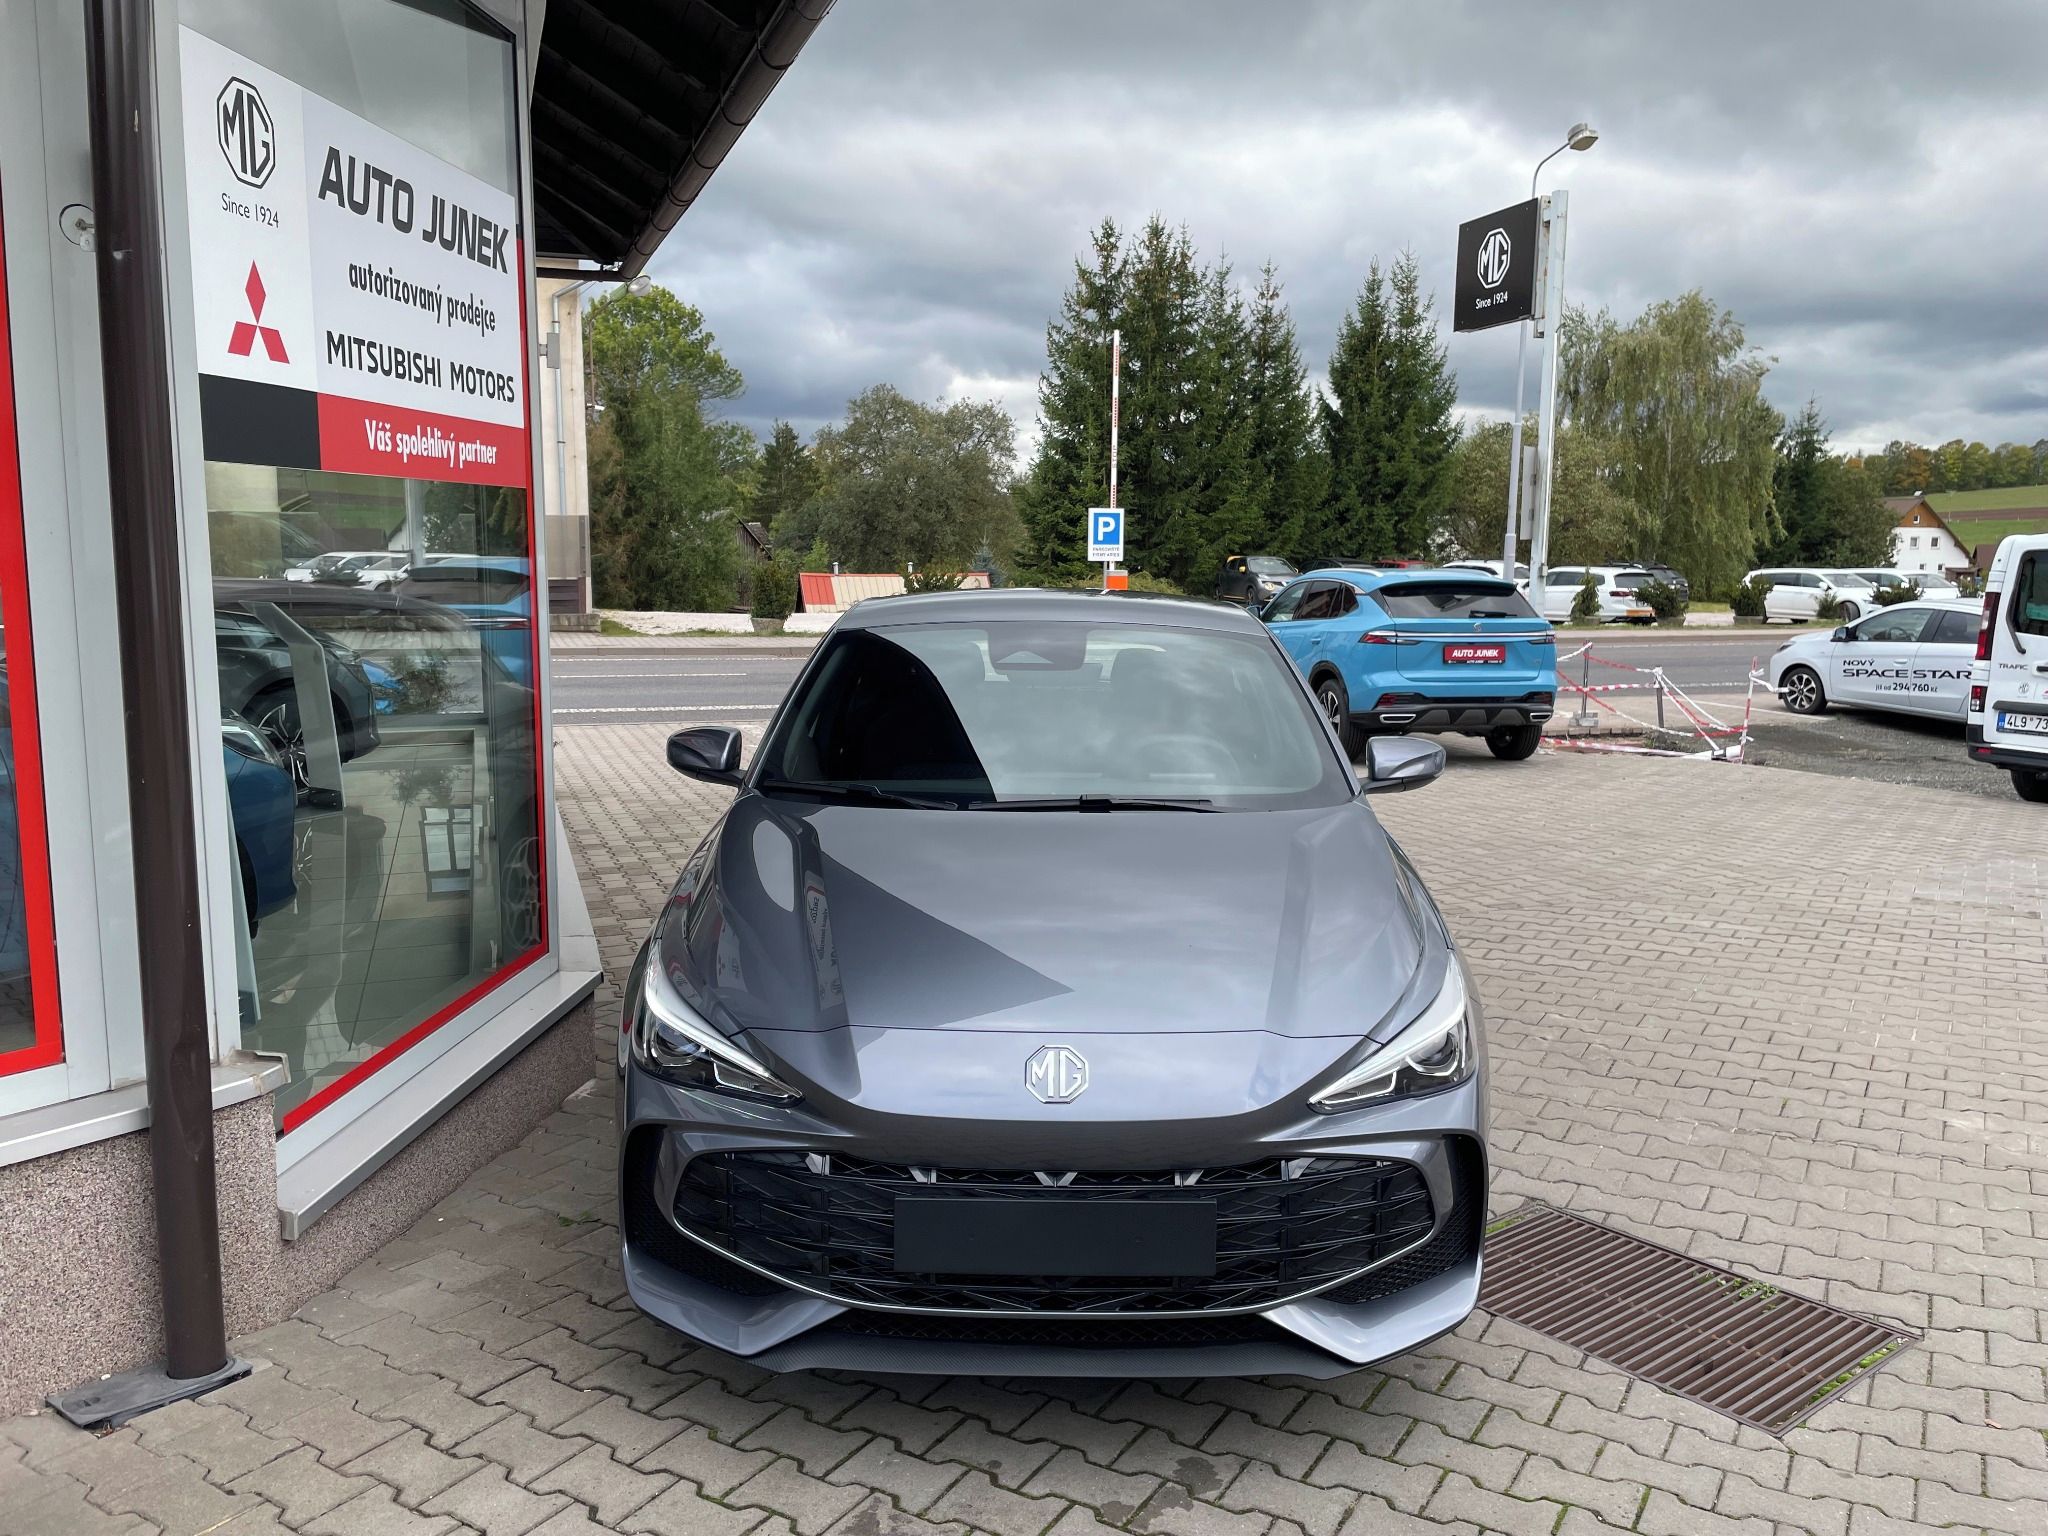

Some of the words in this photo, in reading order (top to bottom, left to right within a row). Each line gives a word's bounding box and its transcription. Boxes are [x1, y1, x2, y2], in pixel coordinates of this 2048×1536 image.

[221, 84, 272, 181] MG
[221, 192, 250, 219] Since
[254, 203, 279, 229] 1924
[317, 145, 415, 234] AUTO
[422, 194, 510, 275] JUNEK
[1479, 232, 1508, 284] MG
[349, 262, 443, 324] autorizovaný
[446, 292, 496, 338] prodejce
[1475, 297, 1491, 310] Since
[1493, 290, 1508, 306] 1924
[326, 330, 442, 388] MITSUBISHI
[450, 361, 515, 403] MOTORS
[364, 418, 392, 453] Váš
[396, 424, 456, 468] spolehlivý
[458, 439, 497, 469] partner
[1097, 516, 1116, 542] P
[1452, 648, 1474, 658] AUTO
[1474, 648, 1499, 658] JUNEK
[1842, 658, 1875, 667] NOVÝ
[1998, 663, 2029, 671] TRAFIC
[1842, 668, 1909, 679] SPACE
[1912, 669, 1973, 680] STAR
[1892, 682, 1910, 691] 294
[1912, 682, 1930, 692] 760
[1029, 1049, 1084, 1099] MG
